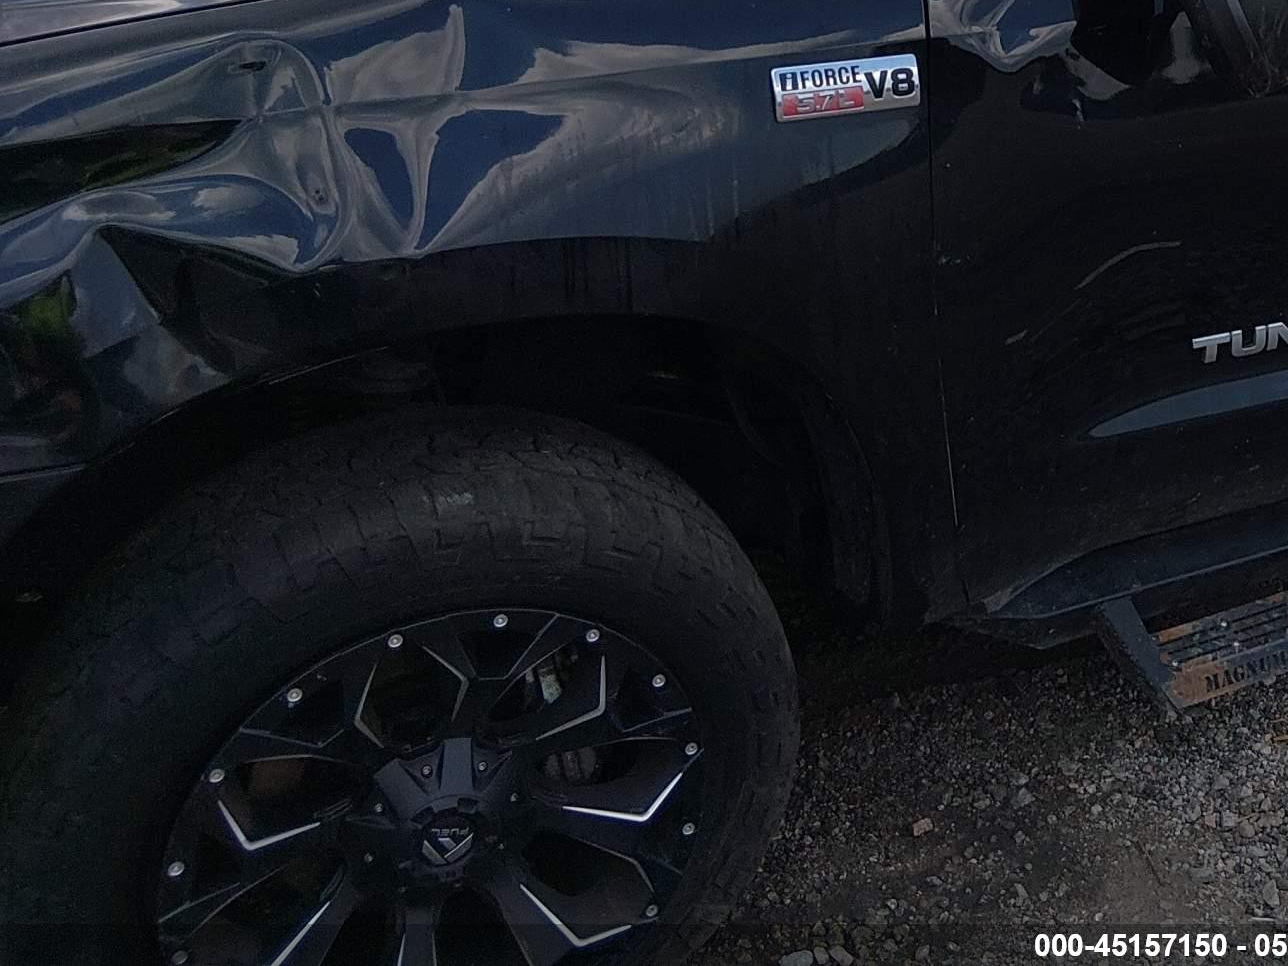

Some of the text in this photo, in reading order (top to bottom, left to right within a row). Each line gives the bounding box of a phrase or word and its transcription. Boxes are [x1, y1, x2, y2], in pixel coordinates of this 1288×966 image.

[864, 67, 916, 100] V8
[796, 91, 856, 114] 5.7L
[1204, 650, 1288, 694] MAGNUM
[431, 825, 470, 837] FUEL
